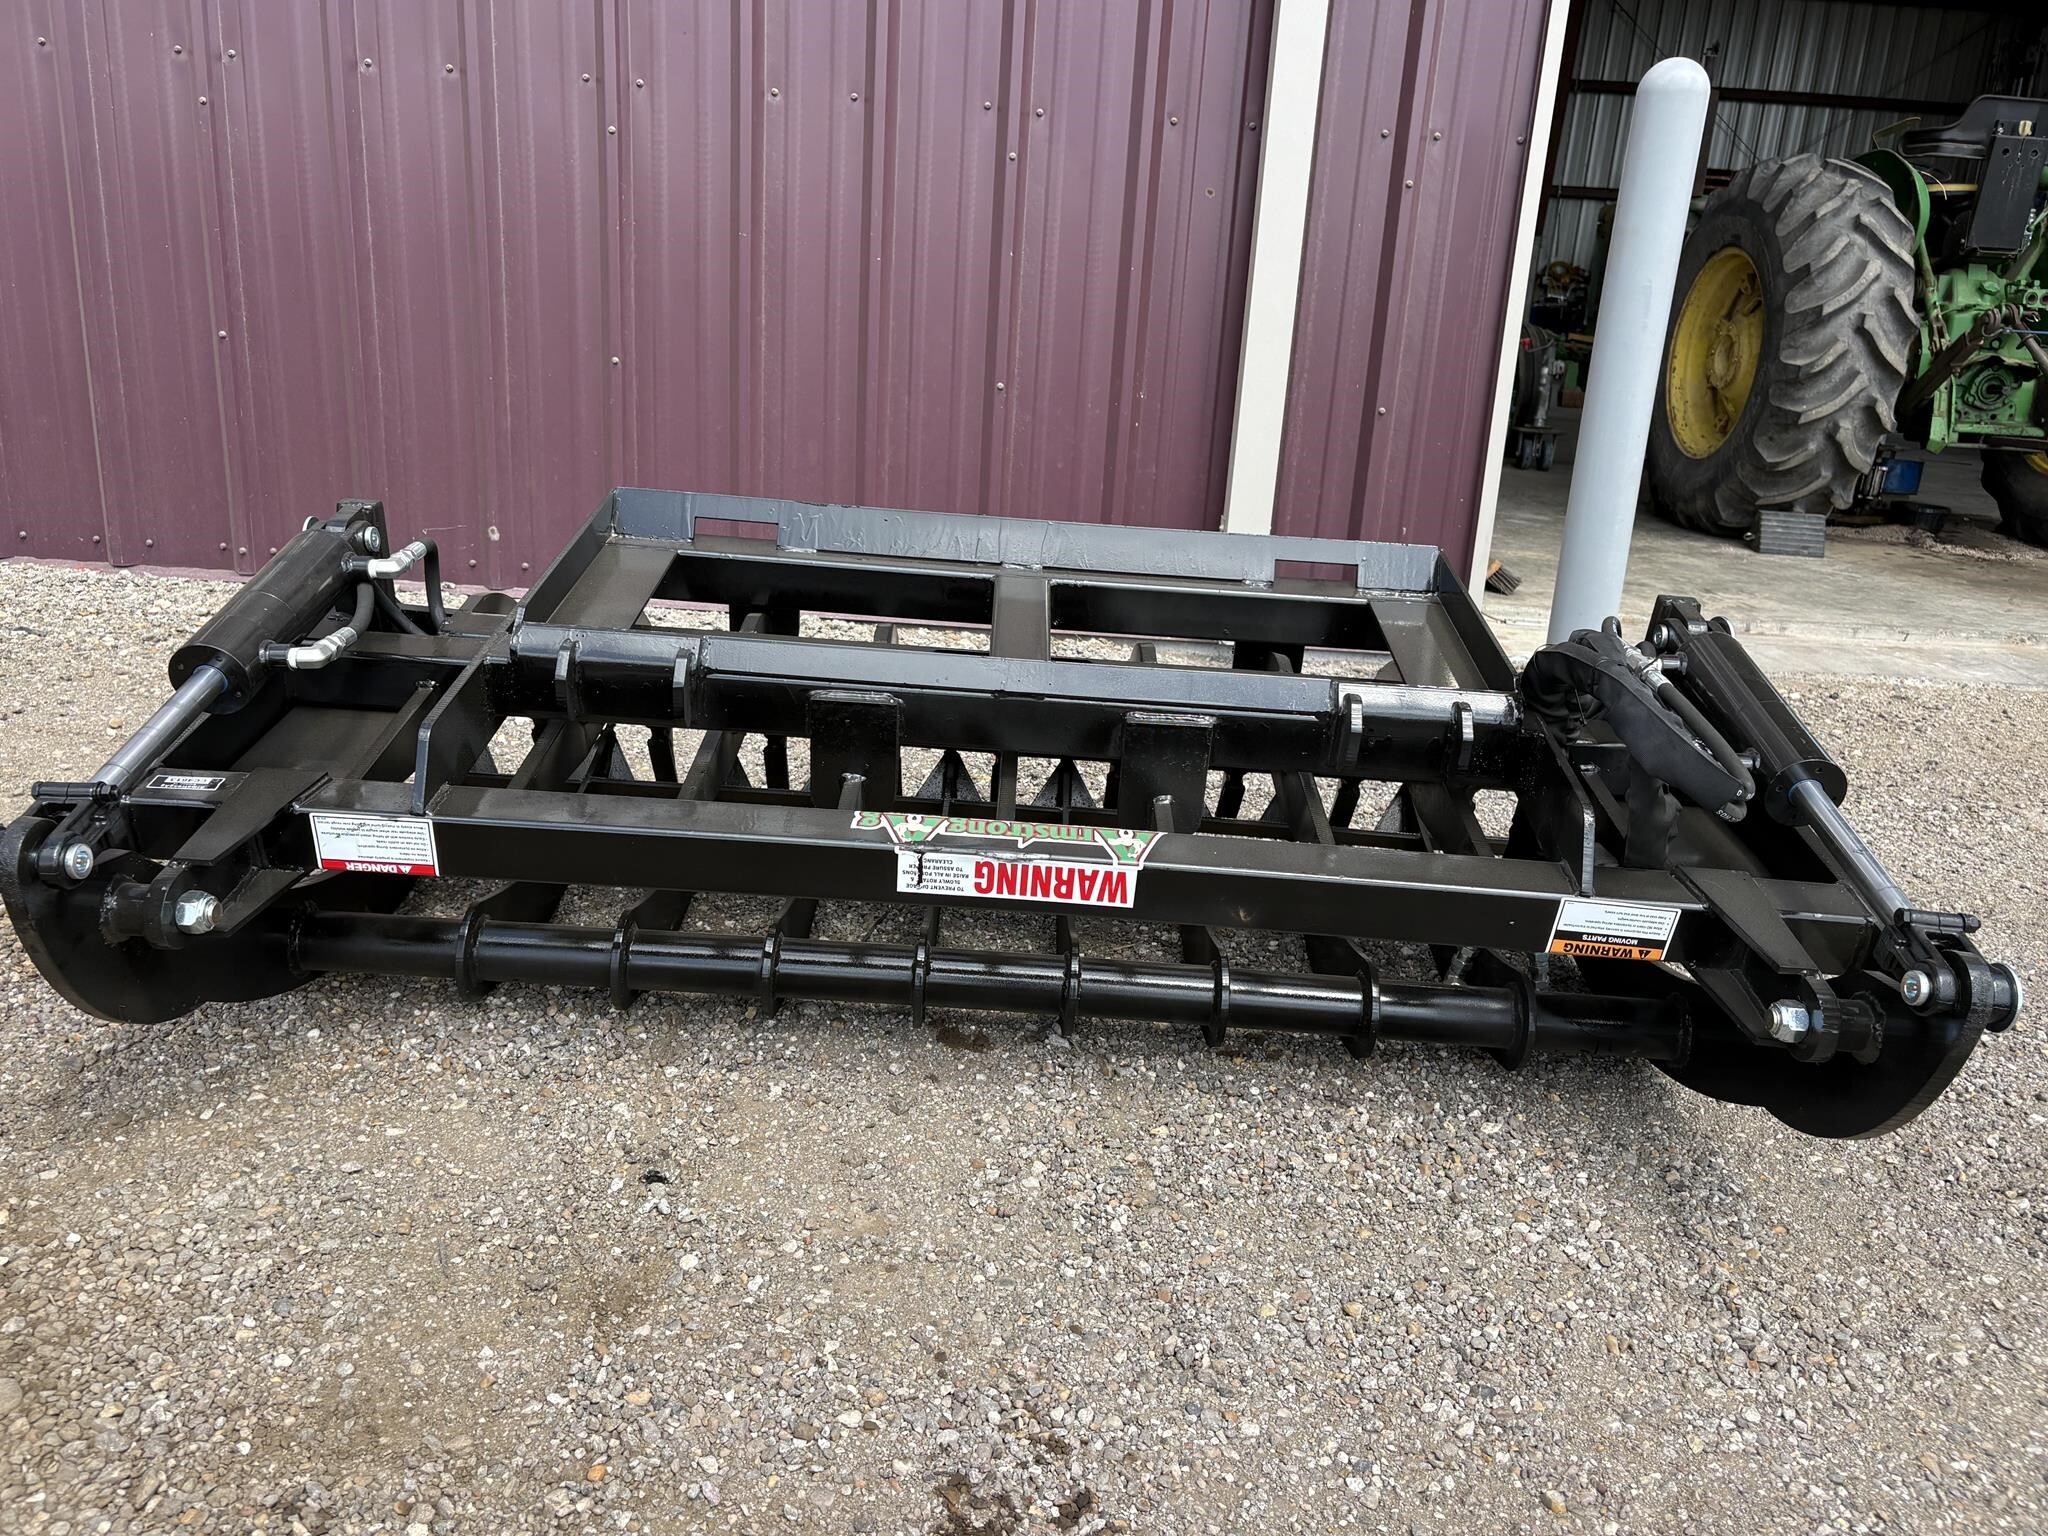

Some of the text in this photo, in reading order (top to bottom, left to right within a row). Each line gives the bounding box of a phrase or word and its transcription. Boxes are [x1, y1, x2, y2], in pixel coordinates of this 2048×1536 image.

[344, 861, 397, 872] DANGER
[973, 860, 1128, 904] WARNING
[1607, 936, 1638, 944] MOVING
[1561, 942, 1634, 957] WARNING
